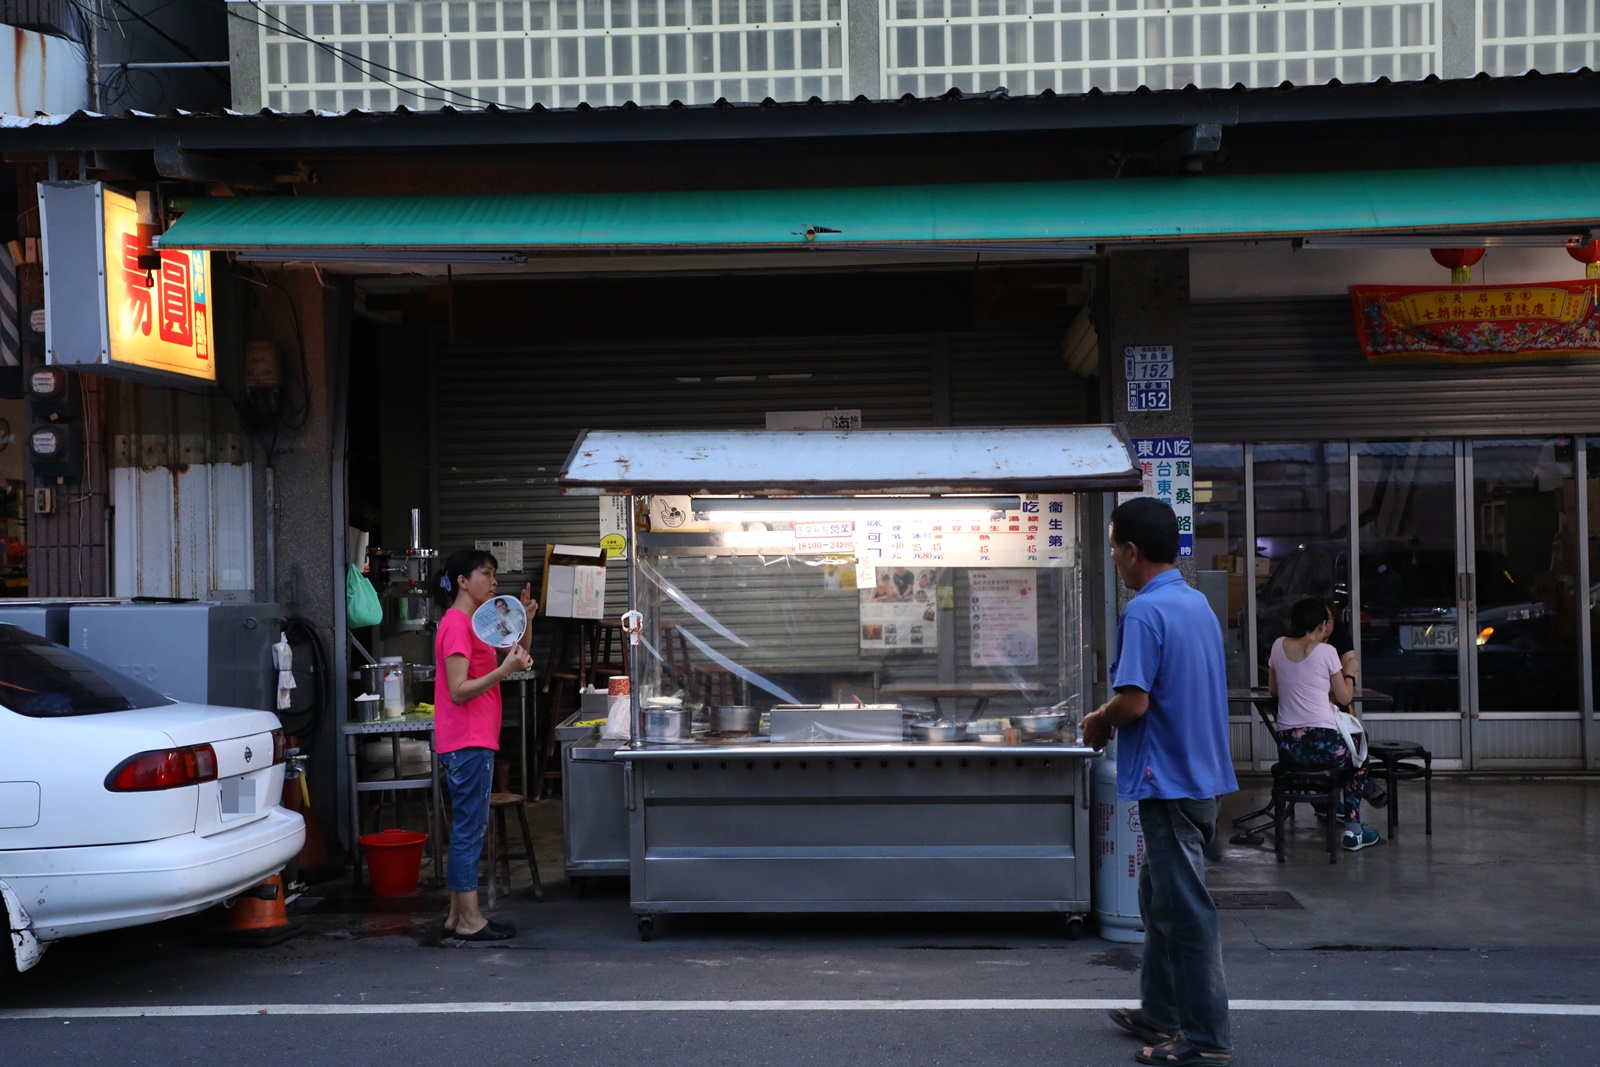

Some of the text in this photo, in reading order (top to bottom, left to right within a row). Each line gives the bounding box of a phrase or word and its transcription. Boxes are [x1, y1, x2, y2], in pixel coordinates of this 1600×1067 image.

[1141, 363, 1169, 378] 152
[1140, 391, 1167, 408] 152
[1134, 439, 1191, 457] 東小吃
[1175, 459, 1191, 532] 寶桑路
[1048, 501, 1063, 559] 衛生第一
